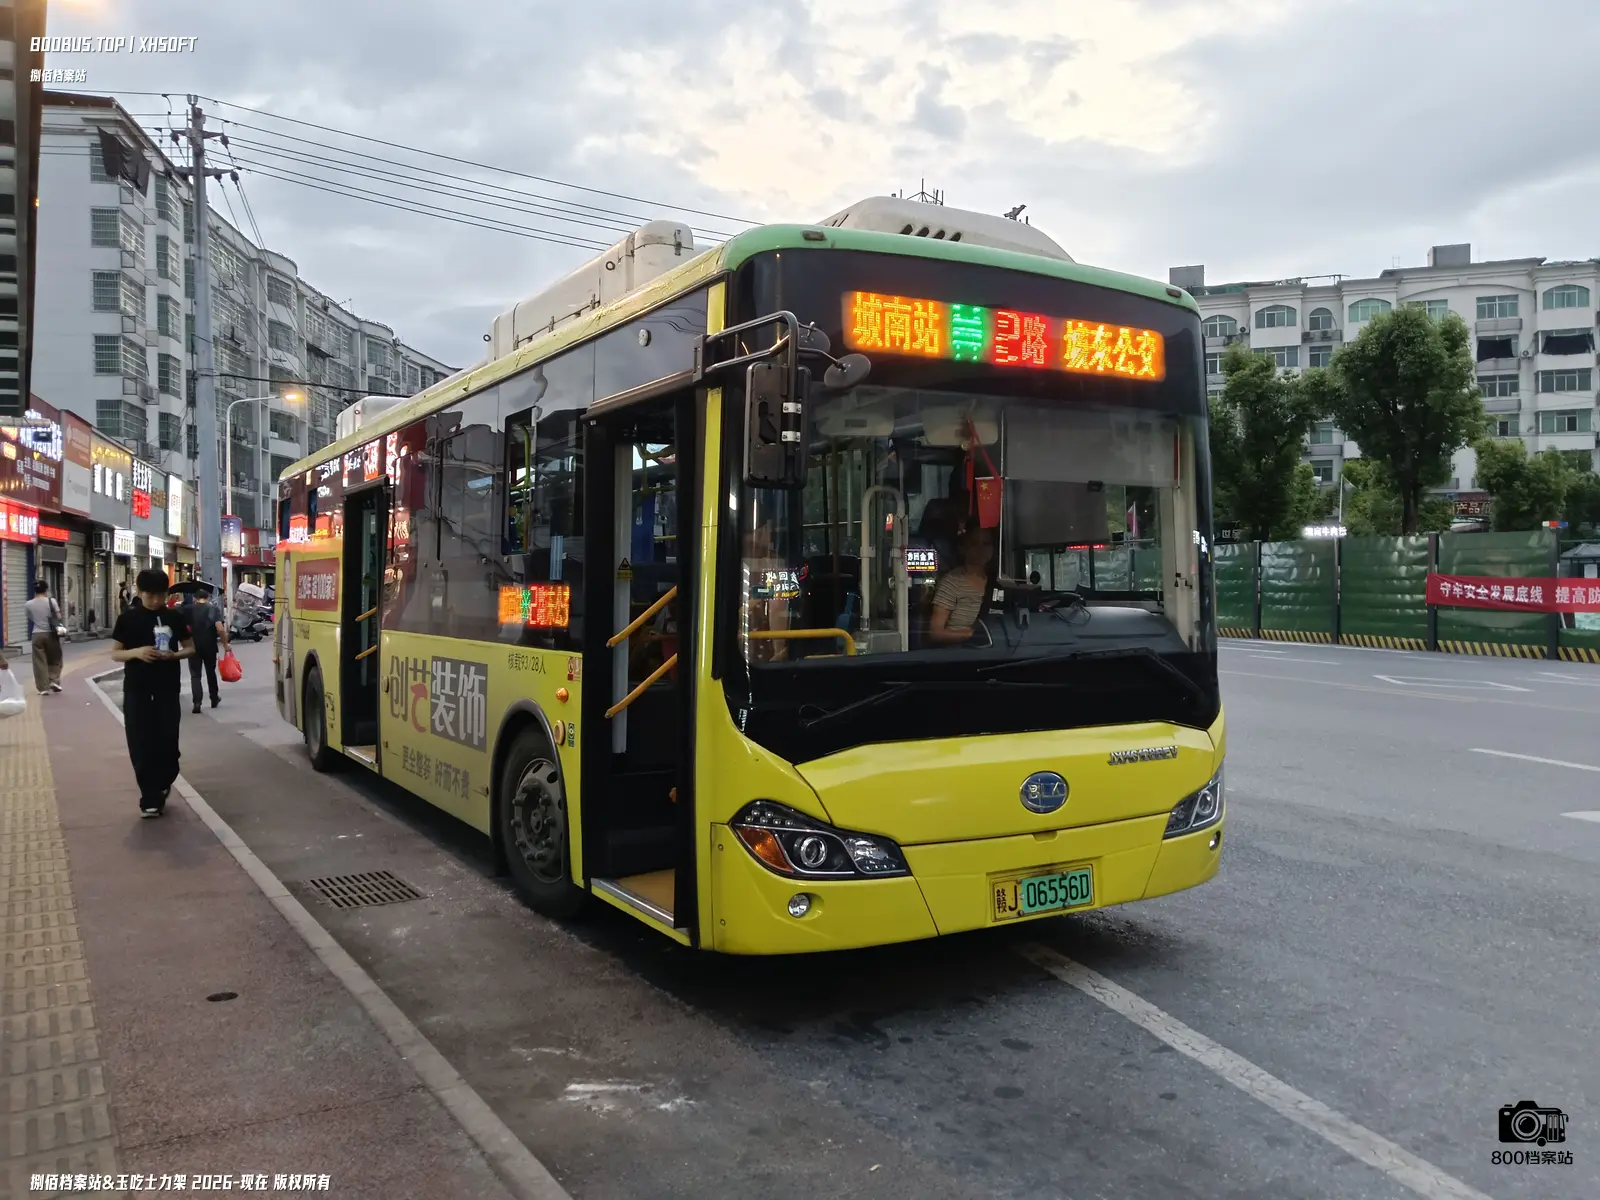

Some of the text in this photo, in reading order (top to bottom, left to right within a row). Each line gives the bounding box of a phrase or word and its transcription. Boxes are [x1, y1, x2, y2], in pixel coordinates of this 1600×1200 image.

[852, 291, 940, 353] 城南站
[1440, 582, 1600, 604] 守牢安全发展底线 提高防
[390, 655, 487, 746] 创艺装饰
